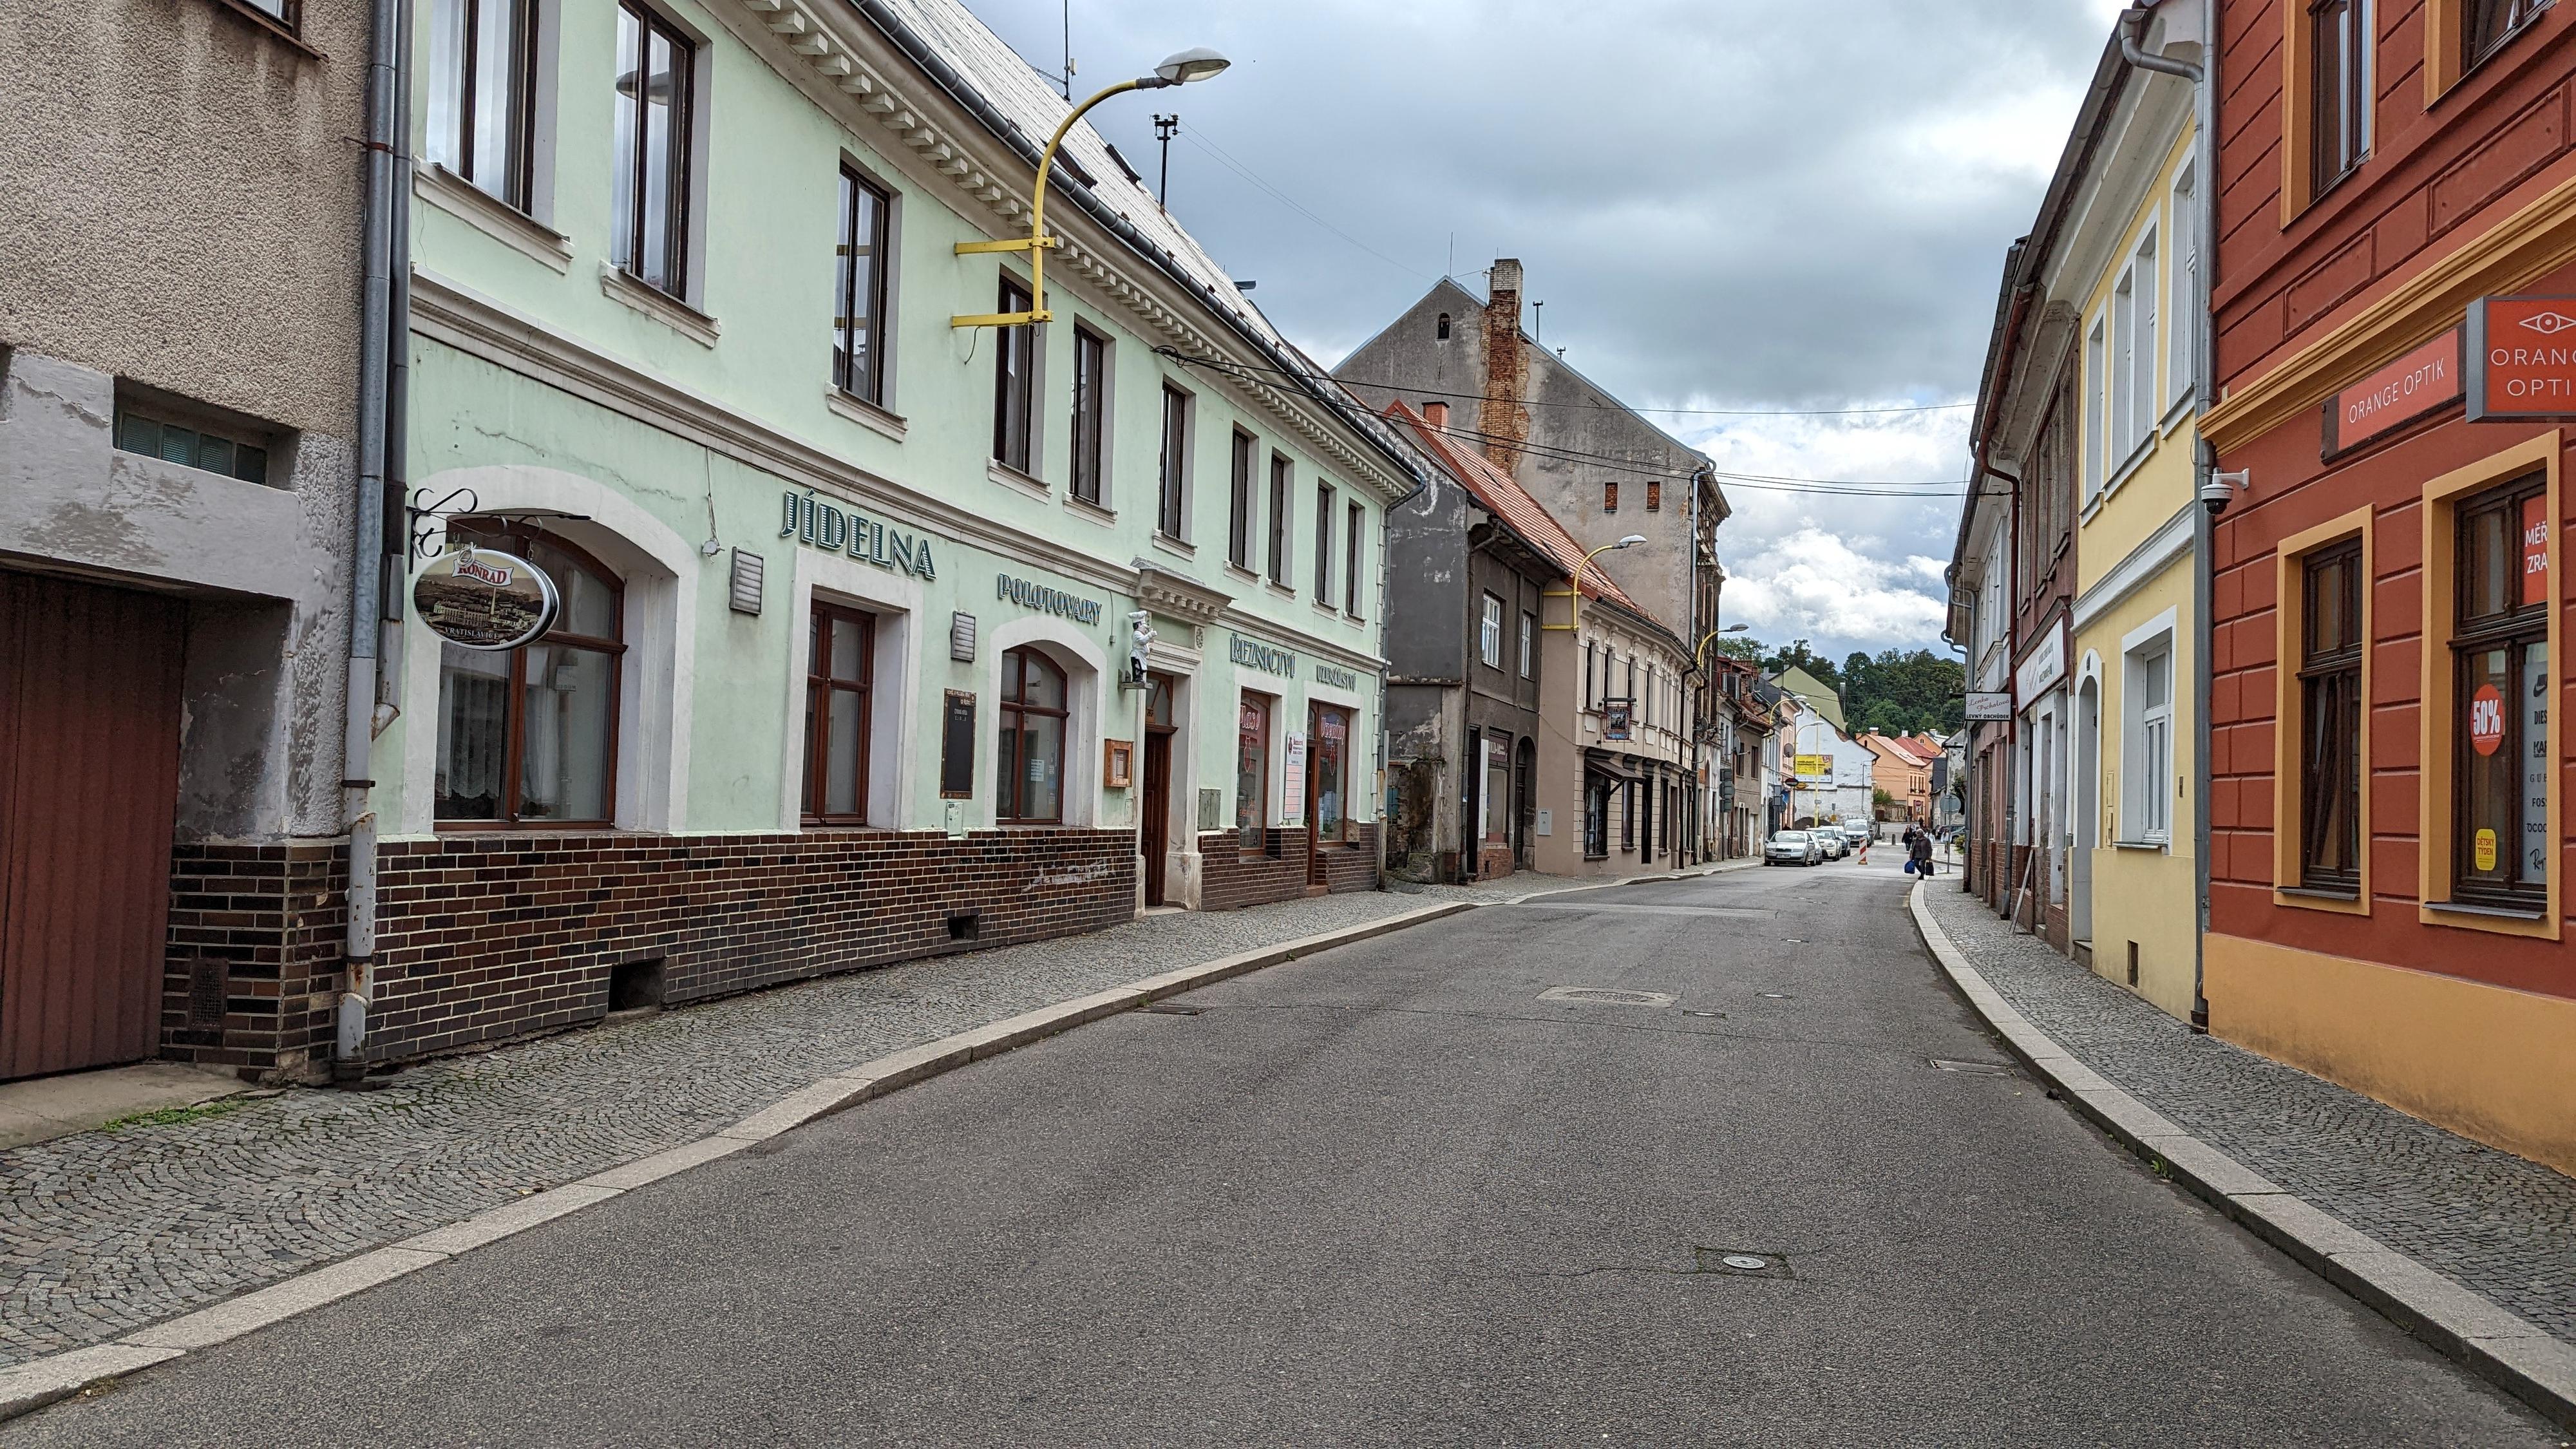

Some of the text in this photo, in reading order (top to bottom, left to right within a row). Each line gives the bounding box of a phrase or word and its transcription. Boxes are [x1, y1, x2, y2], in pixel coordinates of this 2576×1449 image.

[2349, 357, 2444, 424] ORANGE OPTIK
[781, 488, 936, 580] JÍDELNA
[998, 573, 1102, 624] POLOTOVARY
[445, 627, 500, 639] VRATISLAVICE
[1231, 632, 1296, 677] ŘEZNICTVÍ
[2474, 699, 2500, 735] 50%
[2532, 798, 2547, 807] FOS
